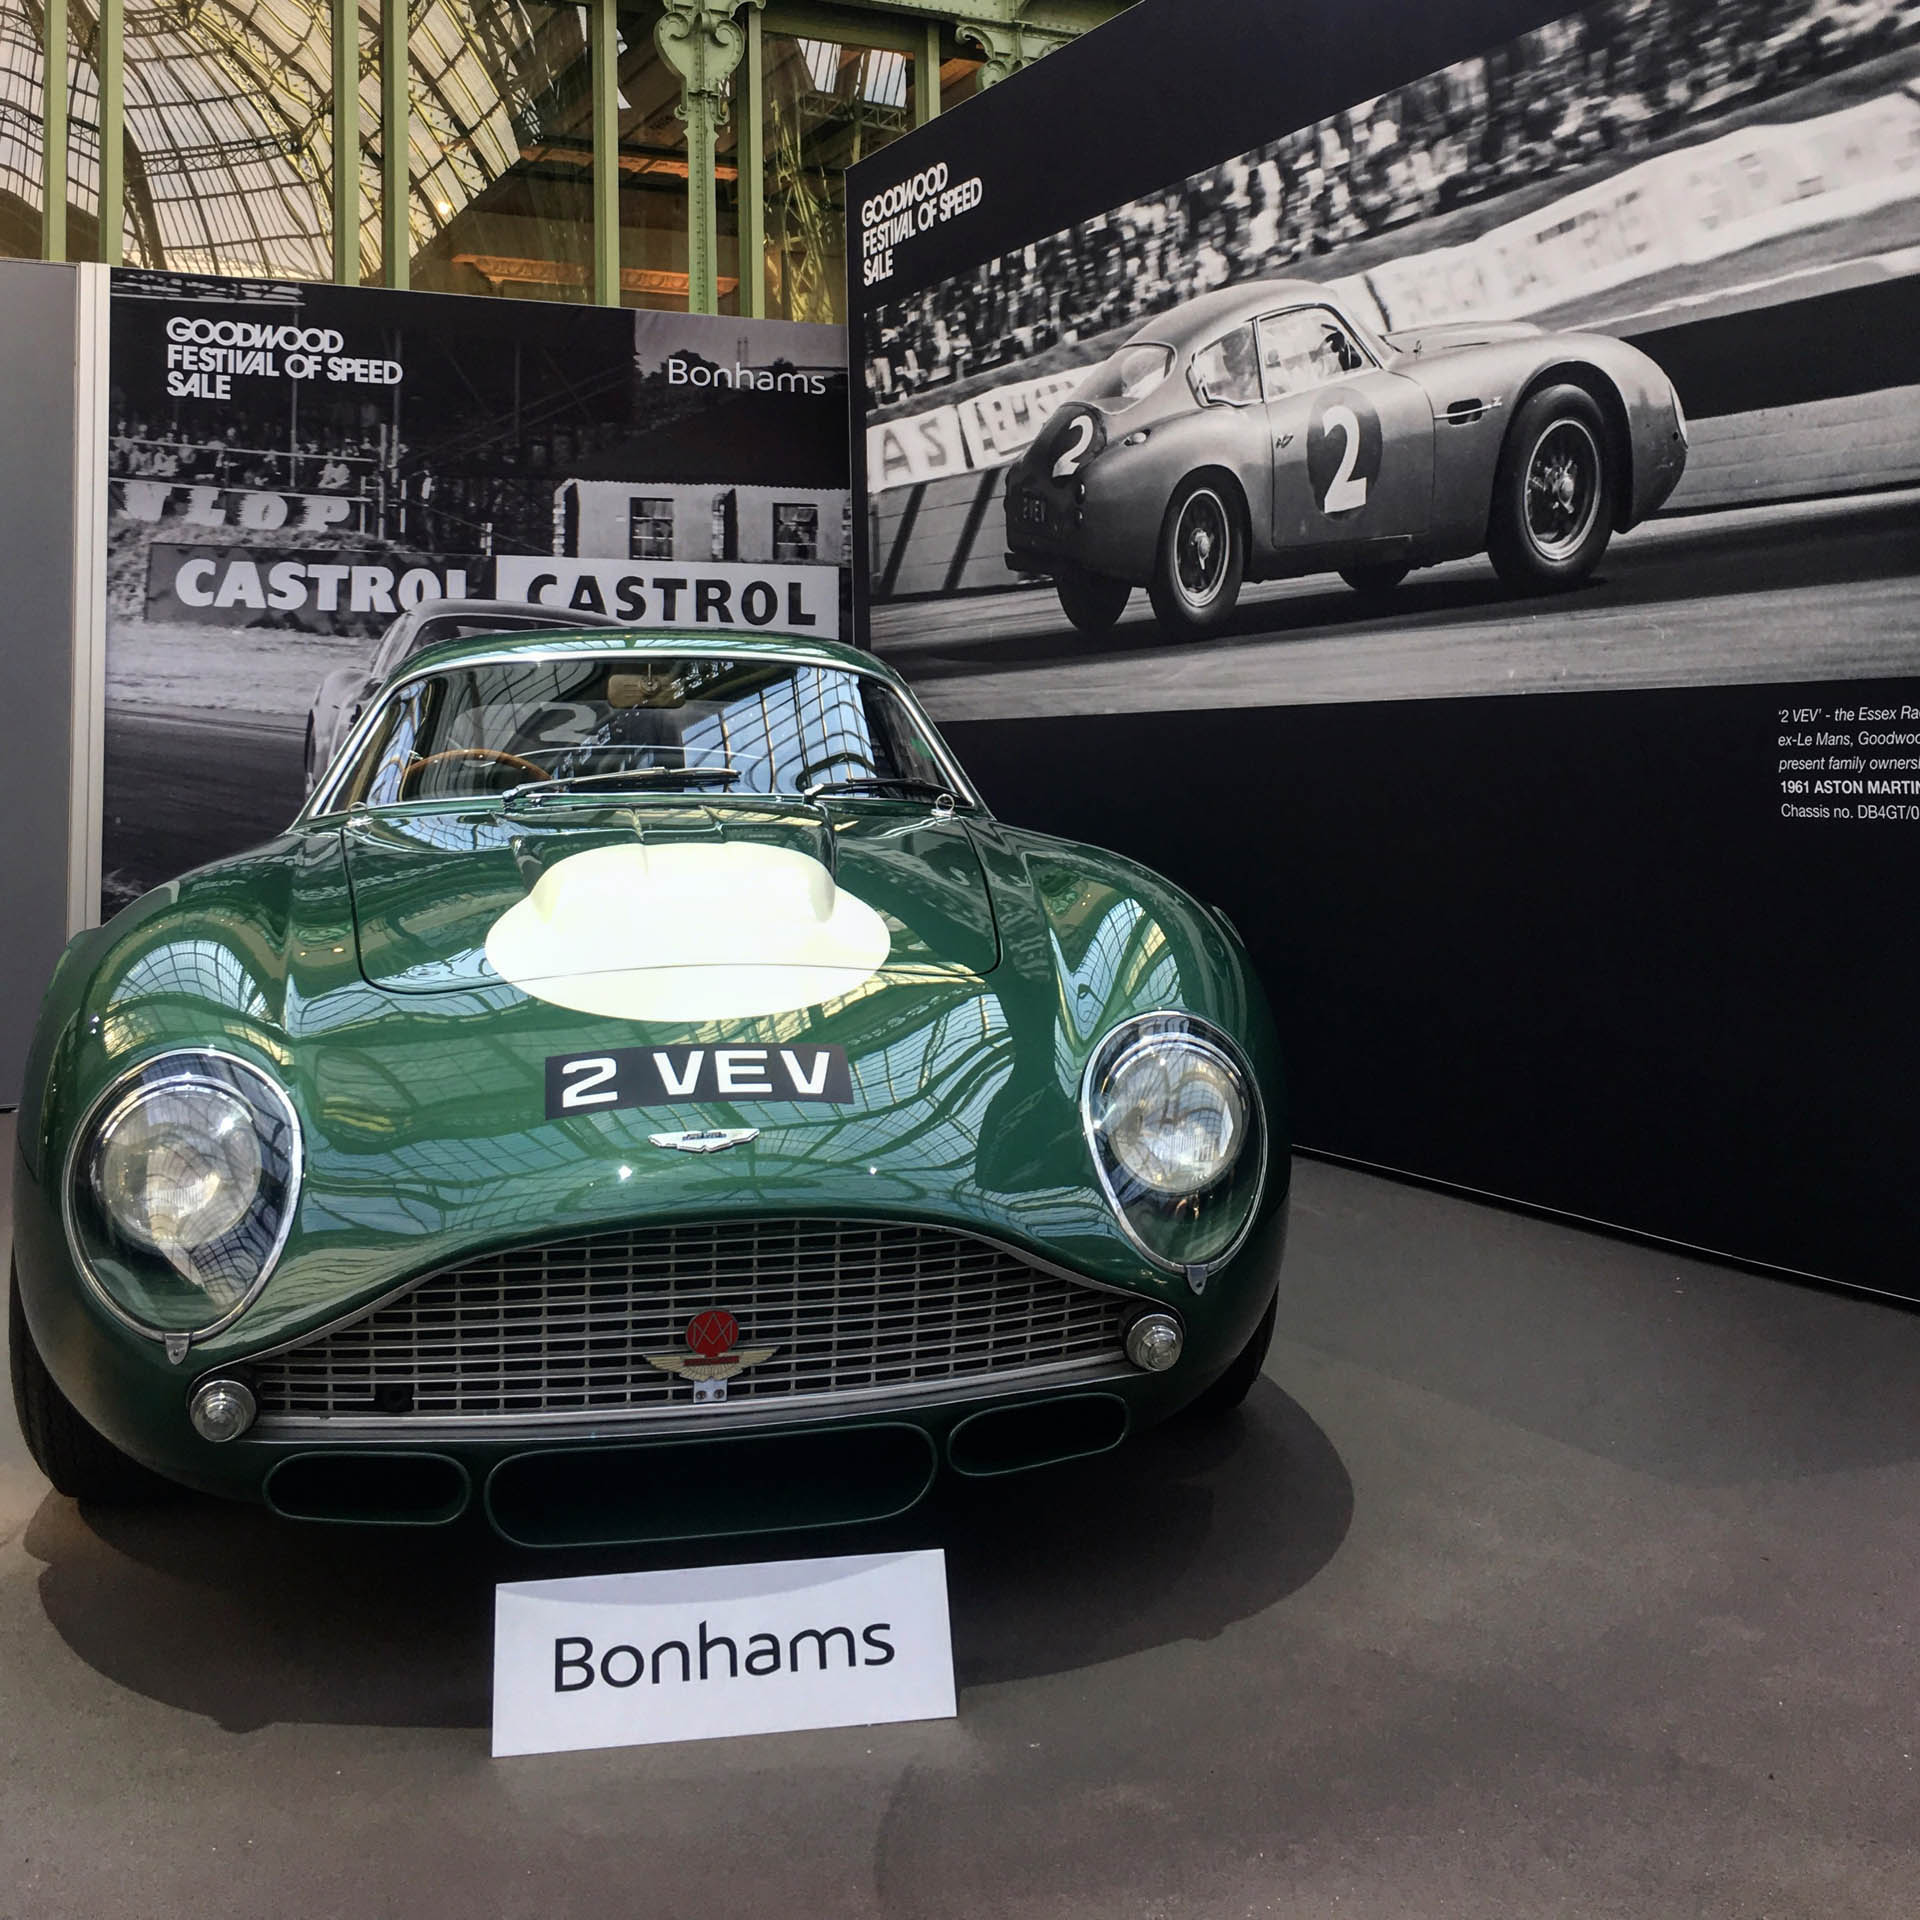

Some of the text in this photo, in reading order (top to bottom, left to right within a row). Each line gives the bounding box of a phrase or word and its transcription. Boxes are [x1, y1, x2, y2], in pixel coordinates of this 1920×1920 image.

[861, 162, 948, 227] GOODWOOD
[863, 177, 983, 258] FESTIVAL OF SPEED
[863, 249, 893, 286] SALE
[166, 317, 344, 354] GOODWOOD
[167, 344, 404, 384] FESTIVAL OF SPEED
[667, 358, 826, 395] Bonhams
[167, 371, 231, 400] SALE
[1051, 415, 1094, 478] 2
[1322, 405, 1367, 514] 2
[527, 573, 816, 626] CASTROL
[1793, 709, 1821, 722] VEV'
[1835, 708, 1854, 721] the
[1859, 707, 1896, 720] Essex
[1901, 706, 1920, 719] Ra
[1778, 733, 1812, 746] ex-Le
[1816, 732, 1853, 747] Mans,
[1779, 756, 1825, 773] present
[1829, 756, 1866, 773] family
[1781, 780, 1809, 793] 1961
[1814, 780, 1863, 794] ASTON
[1781, 804, 1919, 819] Chassis no. DB4GT/0
[562, 1050, 830, 1108] 2 VEV
[554, 1620, 895, 1693] Bonhams
